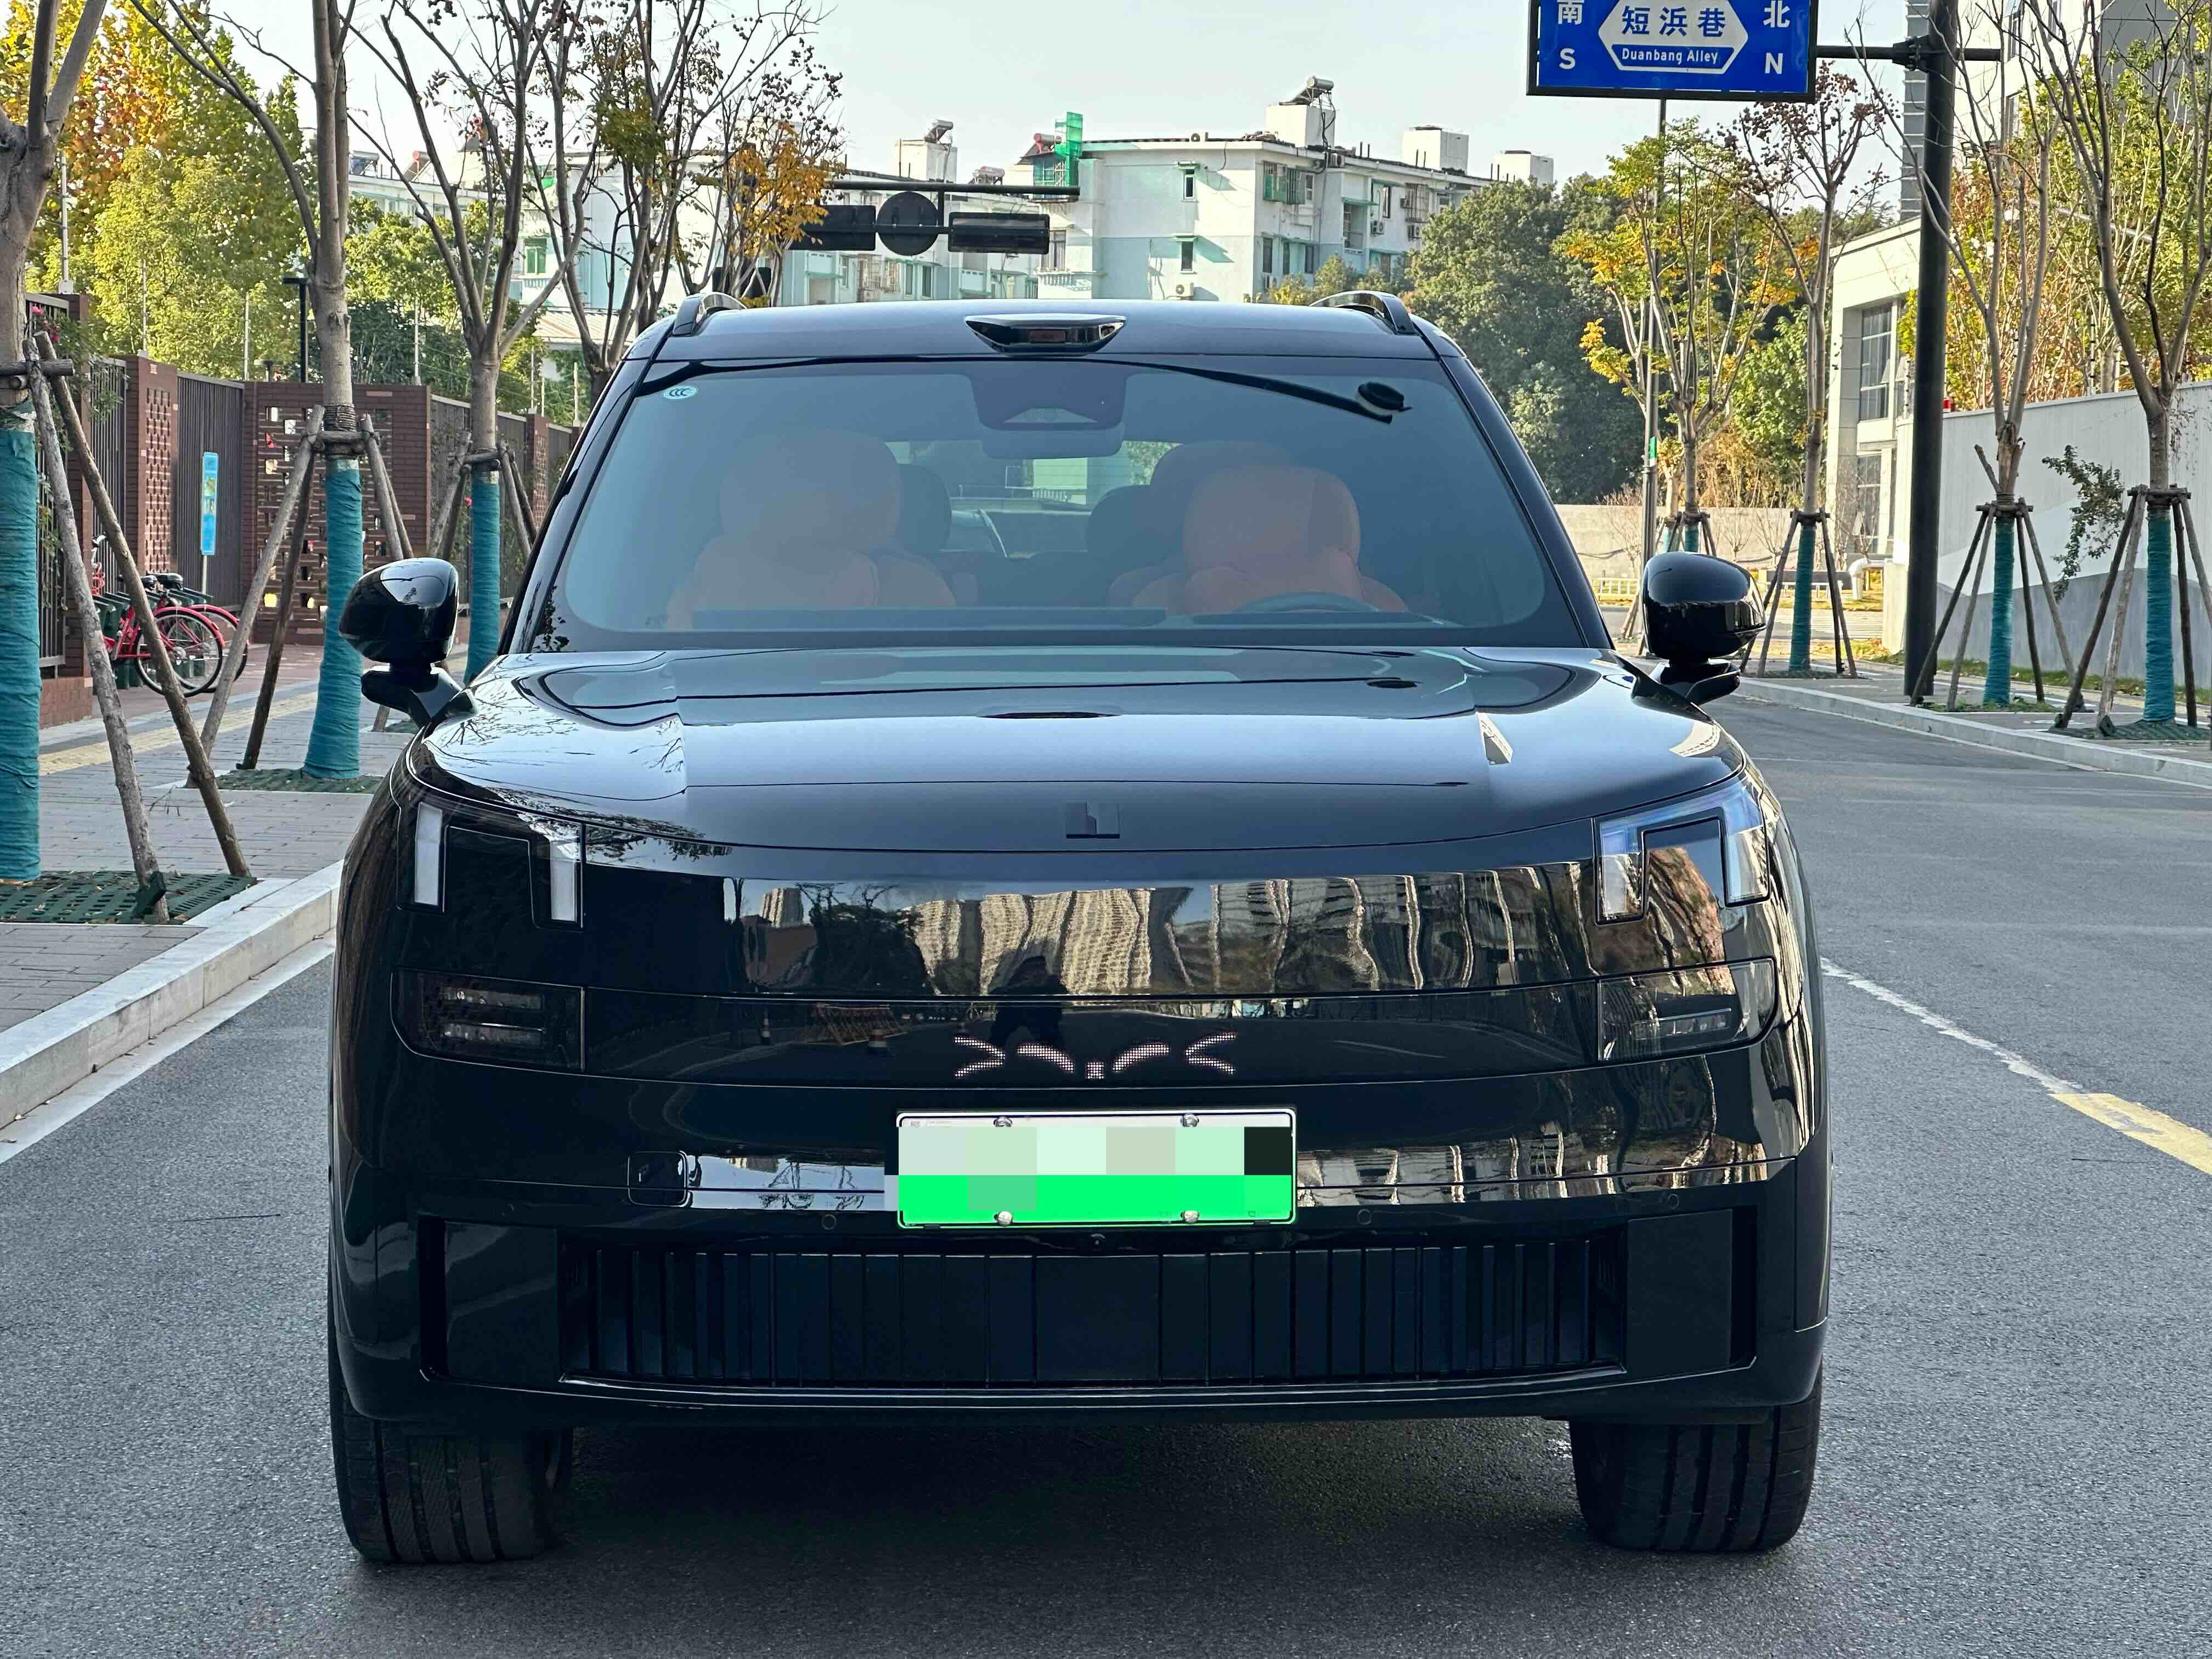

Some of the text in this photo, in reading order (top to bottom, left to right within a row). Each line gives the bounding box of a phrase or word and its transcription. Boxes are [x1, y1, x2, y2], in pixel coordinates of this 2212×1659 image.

[1557, 0, 1584, 25] 南
[1622, 6, 1726, 37] 短浜巷
[1763, 0, 1790, 28] 北
[1559, 48, 1576, 70] S
[1622, 48, 1718, 65] Duanbang Alley
[1764, 52, 1784, 75] N
